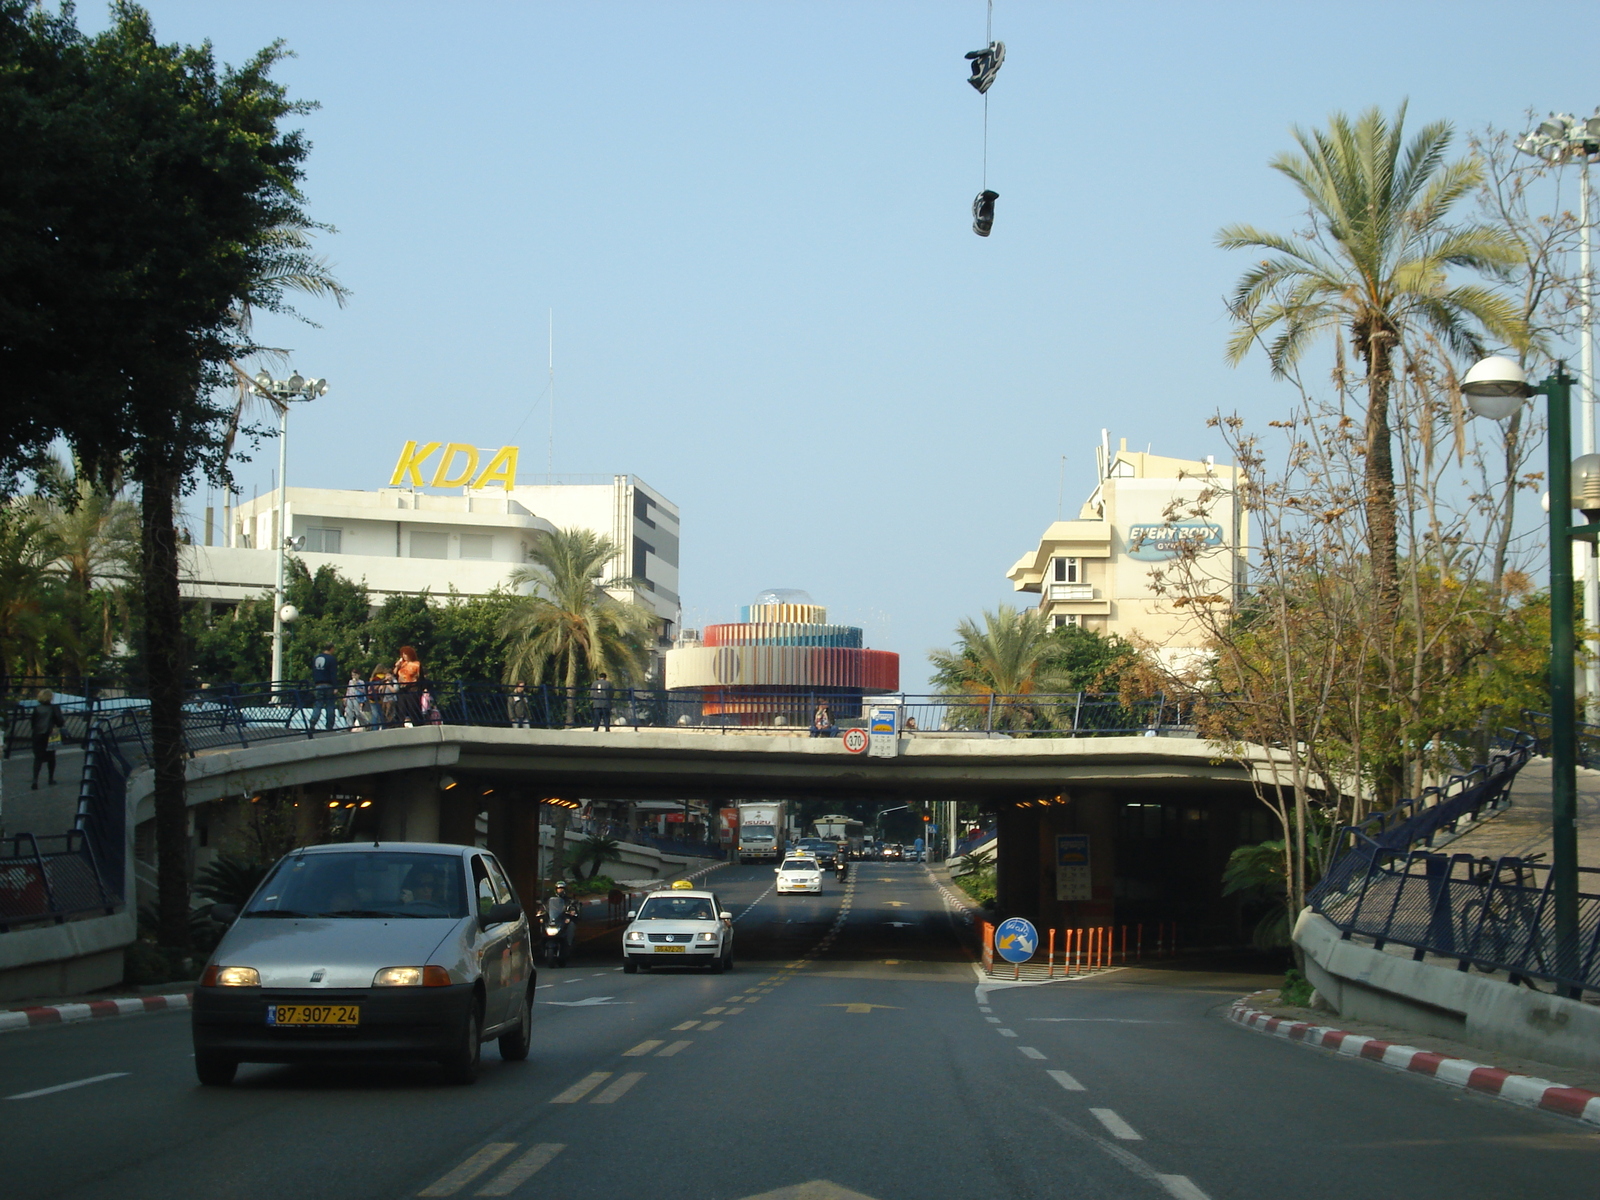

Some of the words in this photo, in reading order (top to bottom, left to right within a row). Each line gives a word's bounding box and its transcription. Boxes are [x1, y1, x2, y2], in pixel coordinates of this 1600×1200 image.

[389, 440, 519, 491] KDA
[1130, 526, 1178, 540] EVERY
[1178, 526, 1219, 540] BODY
